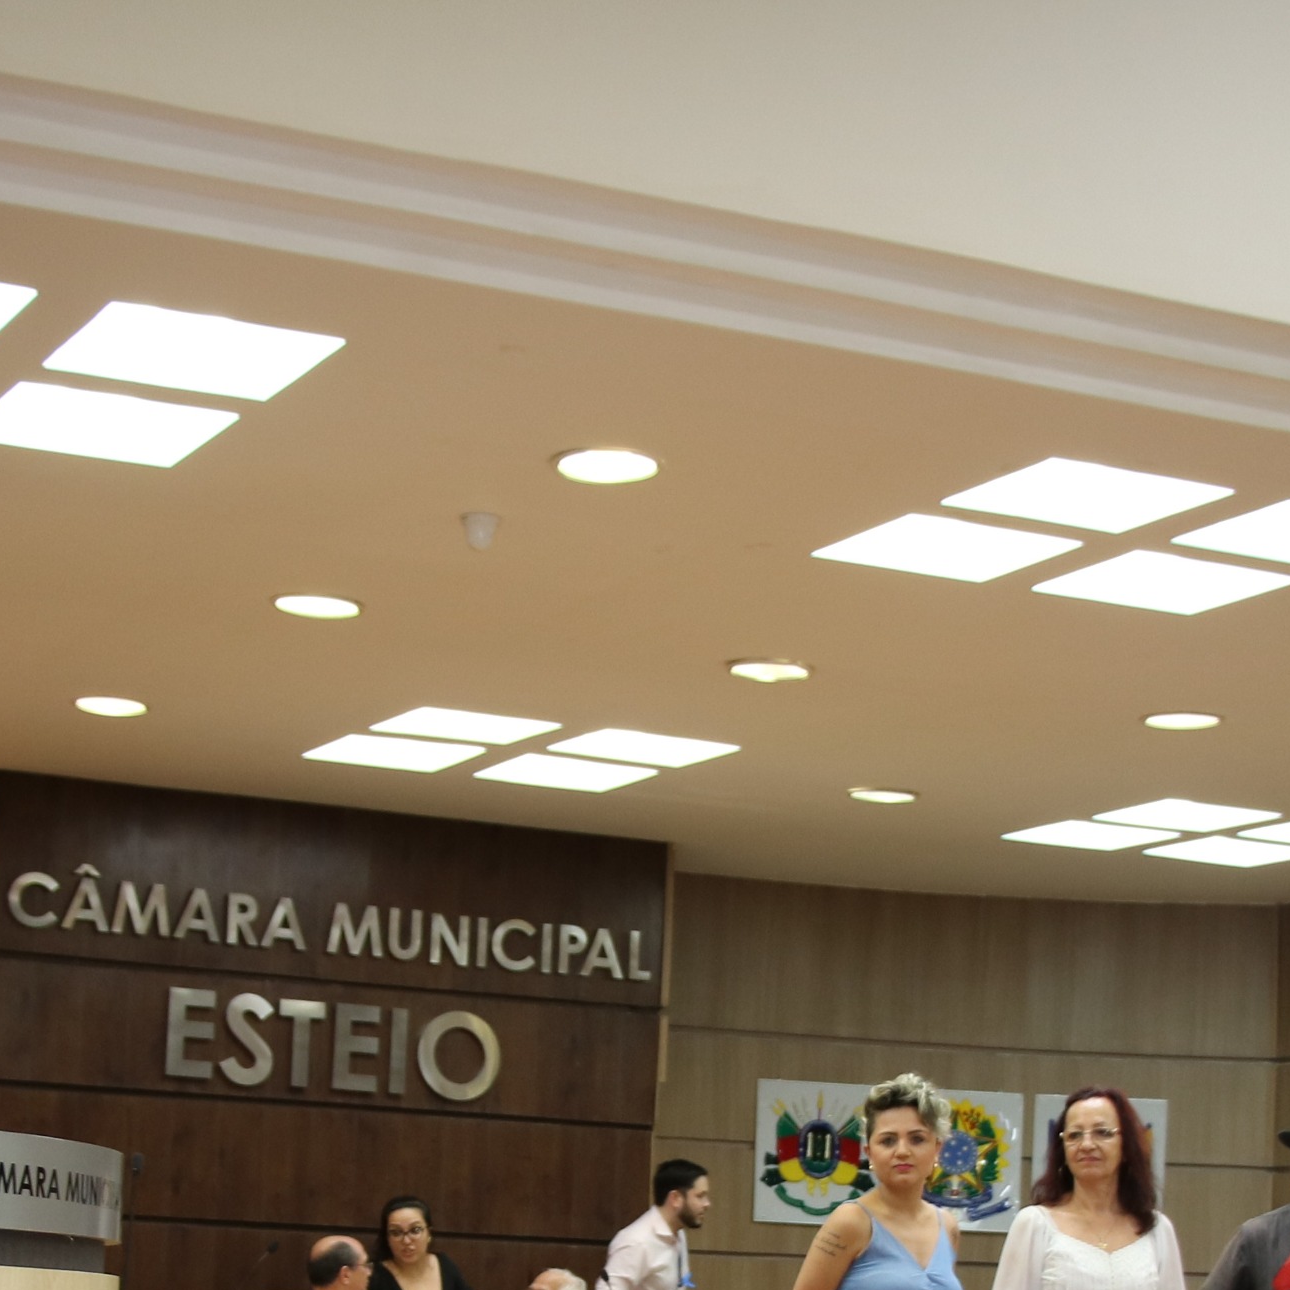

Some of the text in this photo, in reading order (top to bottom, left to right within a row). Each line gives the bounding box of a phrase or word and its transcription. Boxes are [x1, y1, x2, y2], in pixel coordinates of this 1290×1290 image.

[8, 863, 652, 981] CÂMARA MUNICIPAL
[165, 986, 501, 1101] ESTEIO
